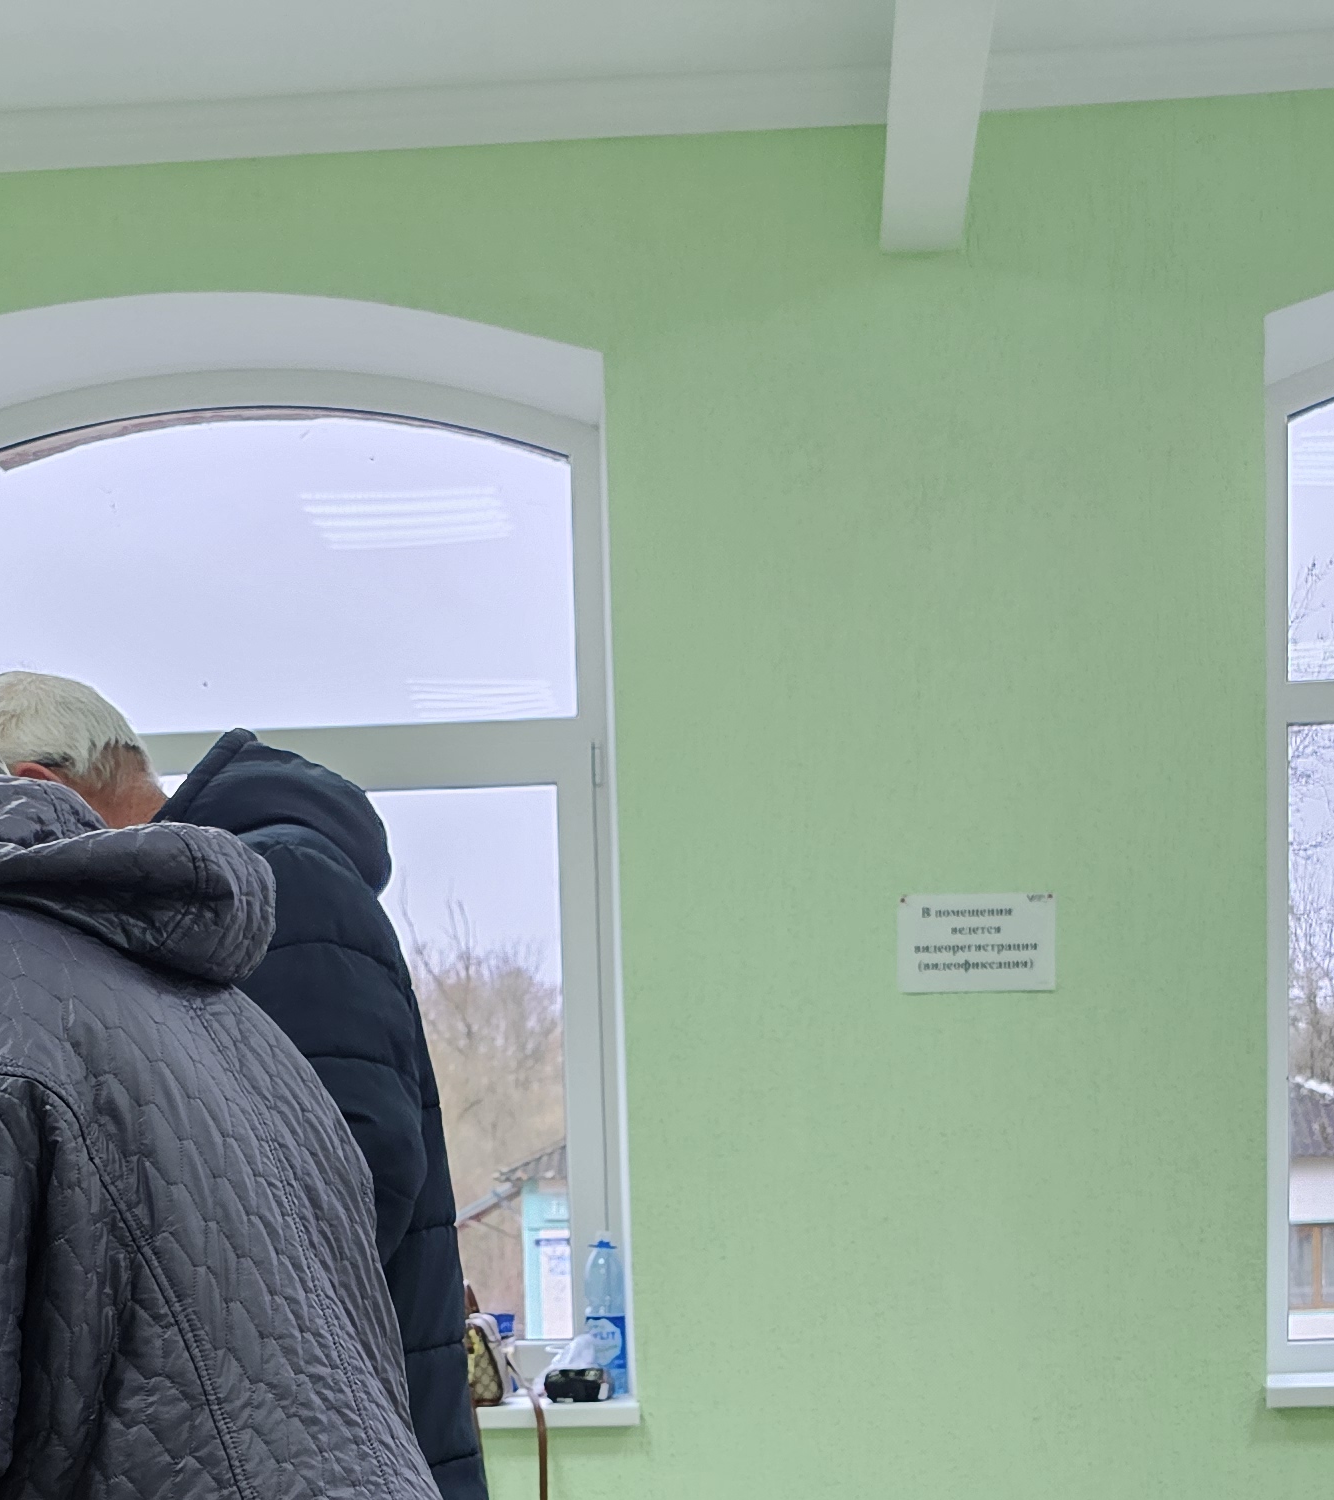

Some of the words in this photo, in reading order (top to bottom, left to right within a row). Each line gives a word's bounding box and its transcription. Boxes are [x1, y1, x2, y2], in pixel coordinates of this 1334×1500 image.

[921, 907, 931, 918] В
[934, 908, 1013, 918] помещении
[950, 926, 1002, 935] ведется
[914, 942, 1038, 956] видеорегистрация
[917, 958, 1034, 973] (видеофиксация)
